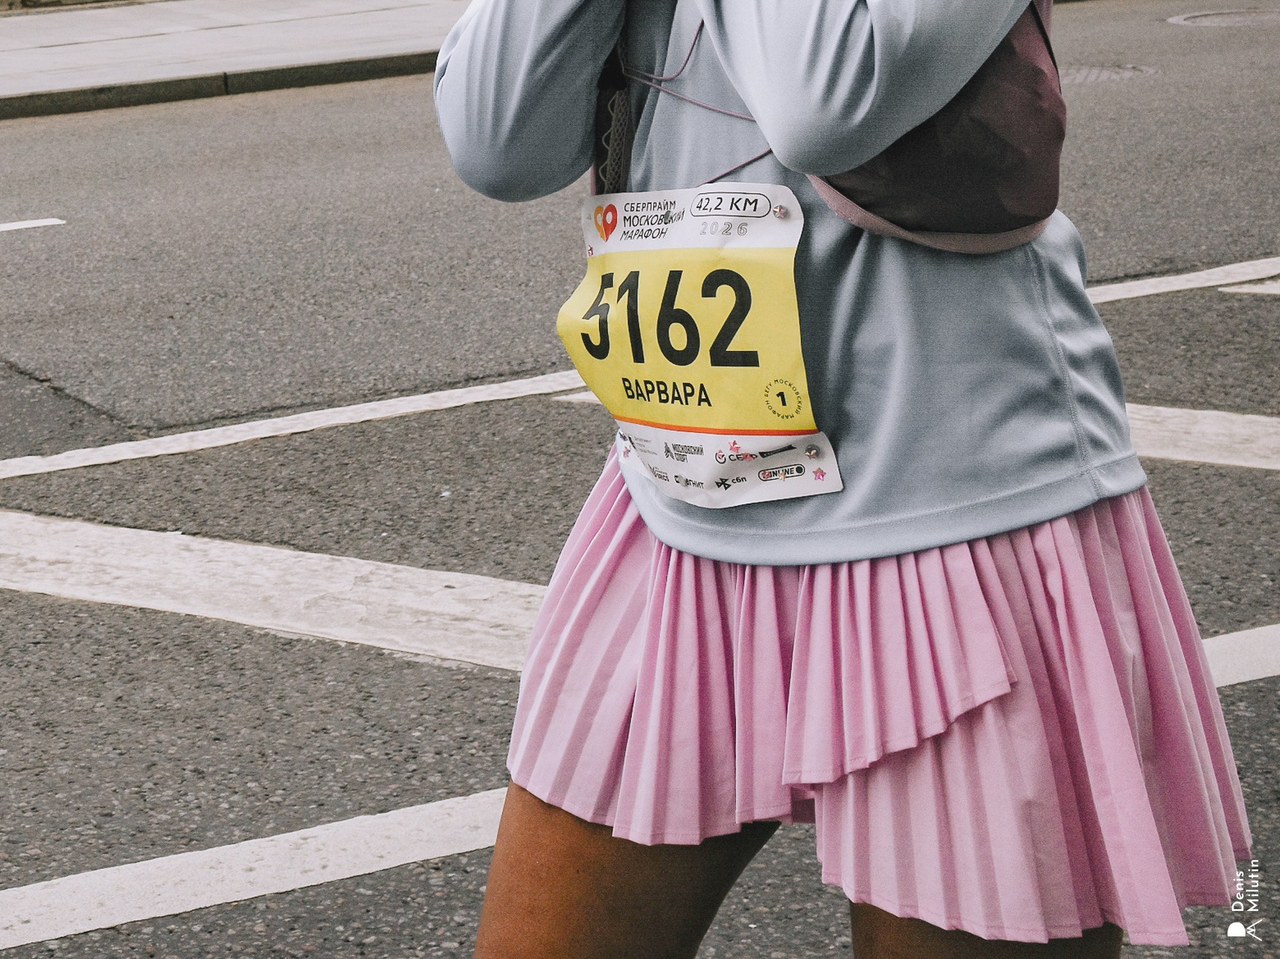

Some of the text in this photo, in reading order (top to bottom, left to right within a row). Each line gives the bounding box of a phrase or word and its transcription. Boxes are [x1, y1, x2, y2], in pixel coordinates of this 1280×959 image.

[623, 199, 677, 213] СБЕРПРАЙМ
[696, 196, 723, 214] 42,2
[620, 227, 669, 242] МАРАФОН
[699, 221, 749, 237] 2026
[580, 268, 760, 368] 5162
[621, 377, 712, 407] ВАРВАРА
[776, 391, 787, 407] 1
[731, 476, 747, 484] сбп
